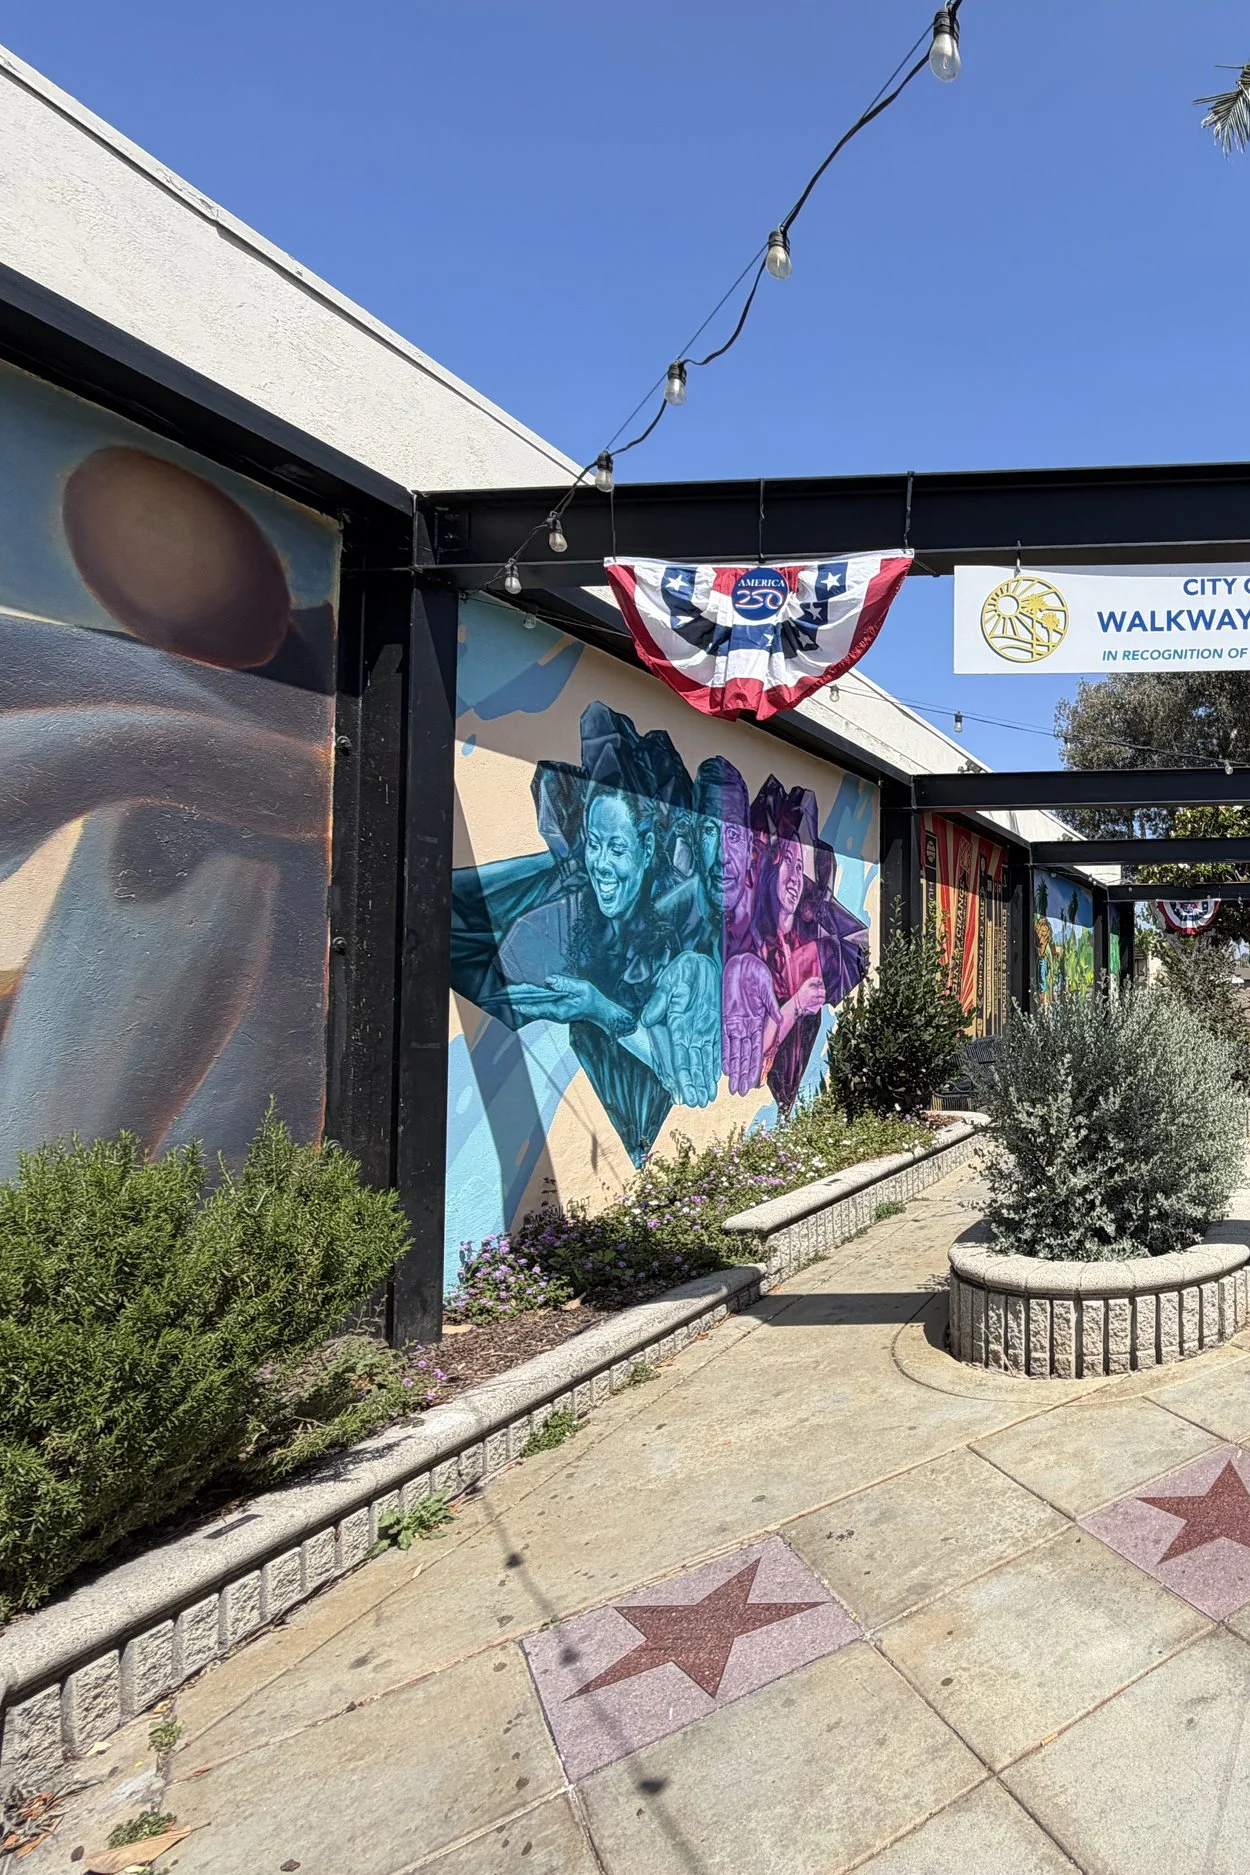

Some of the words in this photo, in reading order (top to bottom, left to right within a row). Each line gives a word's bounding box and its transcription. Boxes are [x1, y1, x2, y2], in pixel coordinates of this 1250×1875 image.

[738, 578, 785, 587] AMERICA
[1183, 577, 1237, 596] CITY
[735, 589, 783, 610] 250
[1102, 649, 1118, 662] IN
[1121, 647, 1223, 661] RECOGNITION
[1227, 647, 1249, 660] OF
[979, 926, 985, 938] OF
